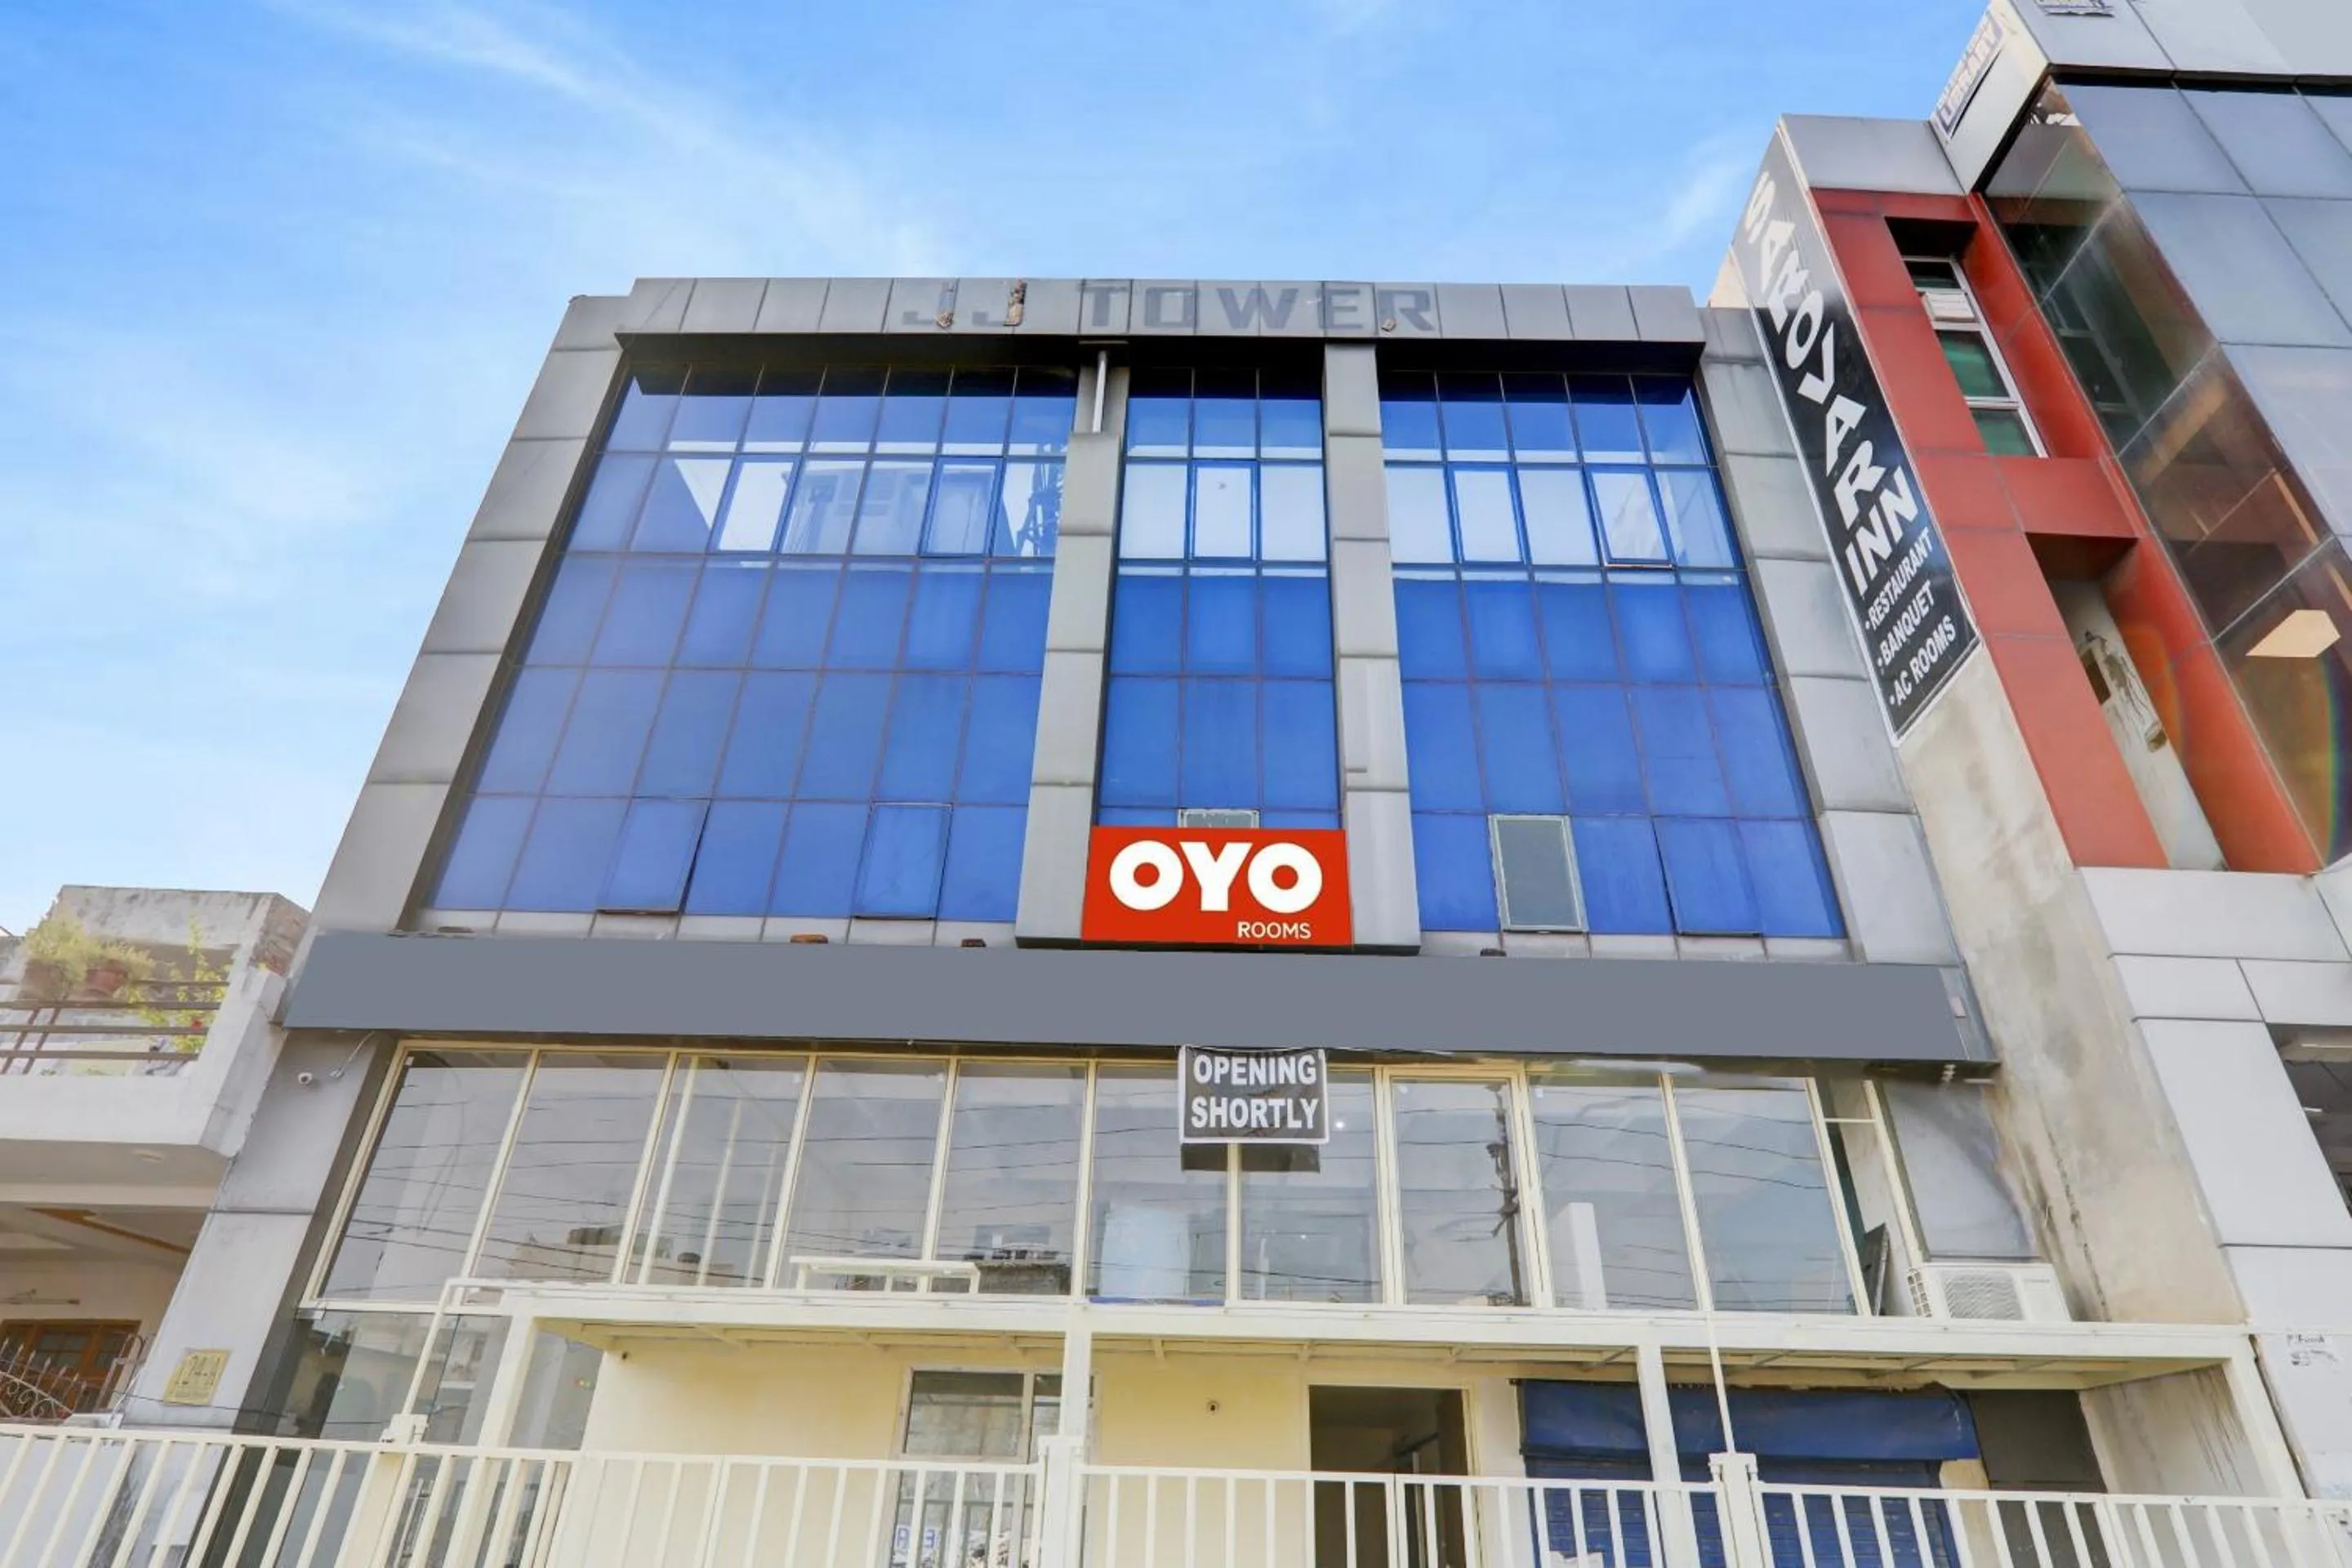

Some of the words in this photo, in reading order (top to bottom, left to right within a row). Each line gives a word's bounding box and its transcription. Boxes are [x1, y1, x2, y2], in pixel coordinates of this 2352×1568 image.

[1076, 283, 1435, 331] TOWER
[1744, 171, 1886, 530] SAROVAR
[1846, 465, 1918, 598] INN
[1868, 527, 1934, 631] RESTAURANT
[1878, 581, 1936, 667] BANQUET
[1894, 670, 1913, 706] AC
[1909, 615, 1957, 684] ROOMS
[1110, 840, 1322, 914] OYO
[1237, 921, 1312, 940] ROOMS
[1192, 1054, 1317, 1085] OPENING
[1191, 1096, 1319, 1129] SHORTLY
